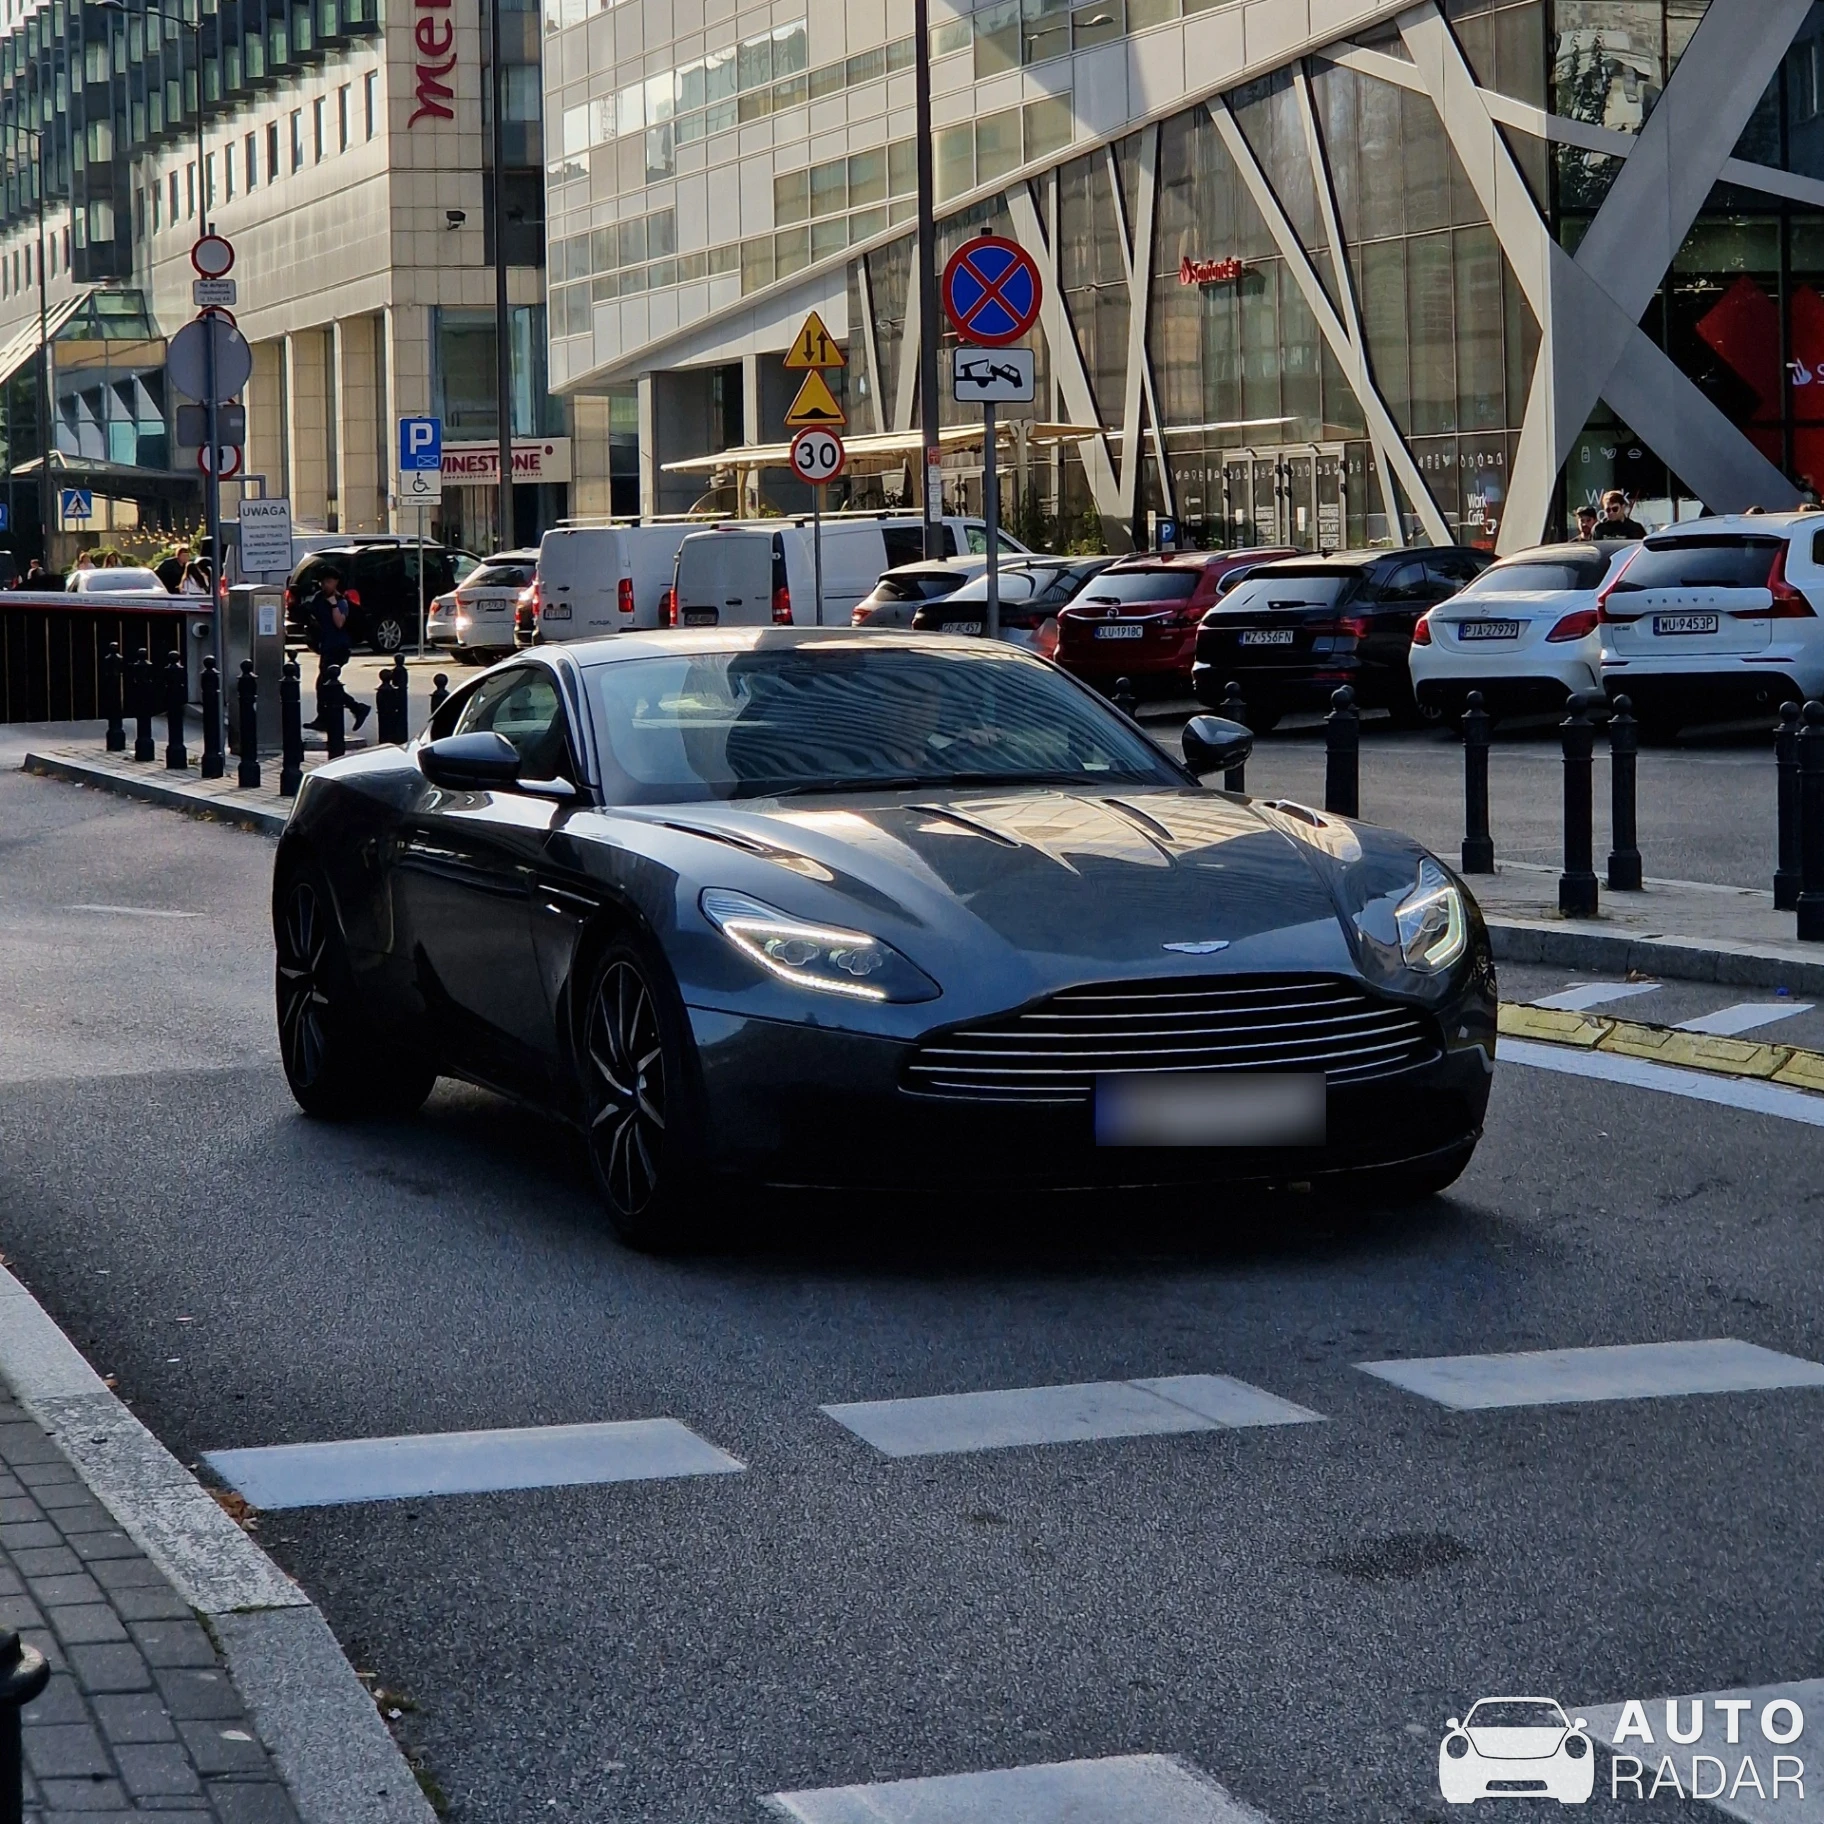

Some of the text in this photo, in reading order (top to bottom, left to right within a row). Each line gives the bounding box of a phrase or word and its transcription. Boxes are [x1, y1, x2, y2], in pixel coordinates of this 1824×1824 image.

[410, 423, 433, 454] P
[798, 442, 837, 469] 30
[1467, 493, 1488, 509] Work
[243, 506, 287, 517] UWAGA
[1468, 510, 1484, 525] Café
[1162, 524, 1171, 538] P
[1464, 623, 1515, 638] PJA 27979
[1661, 616, 1714, 631] WU 9453P
[1243, 631, 1292, 643] WZ 556FN
